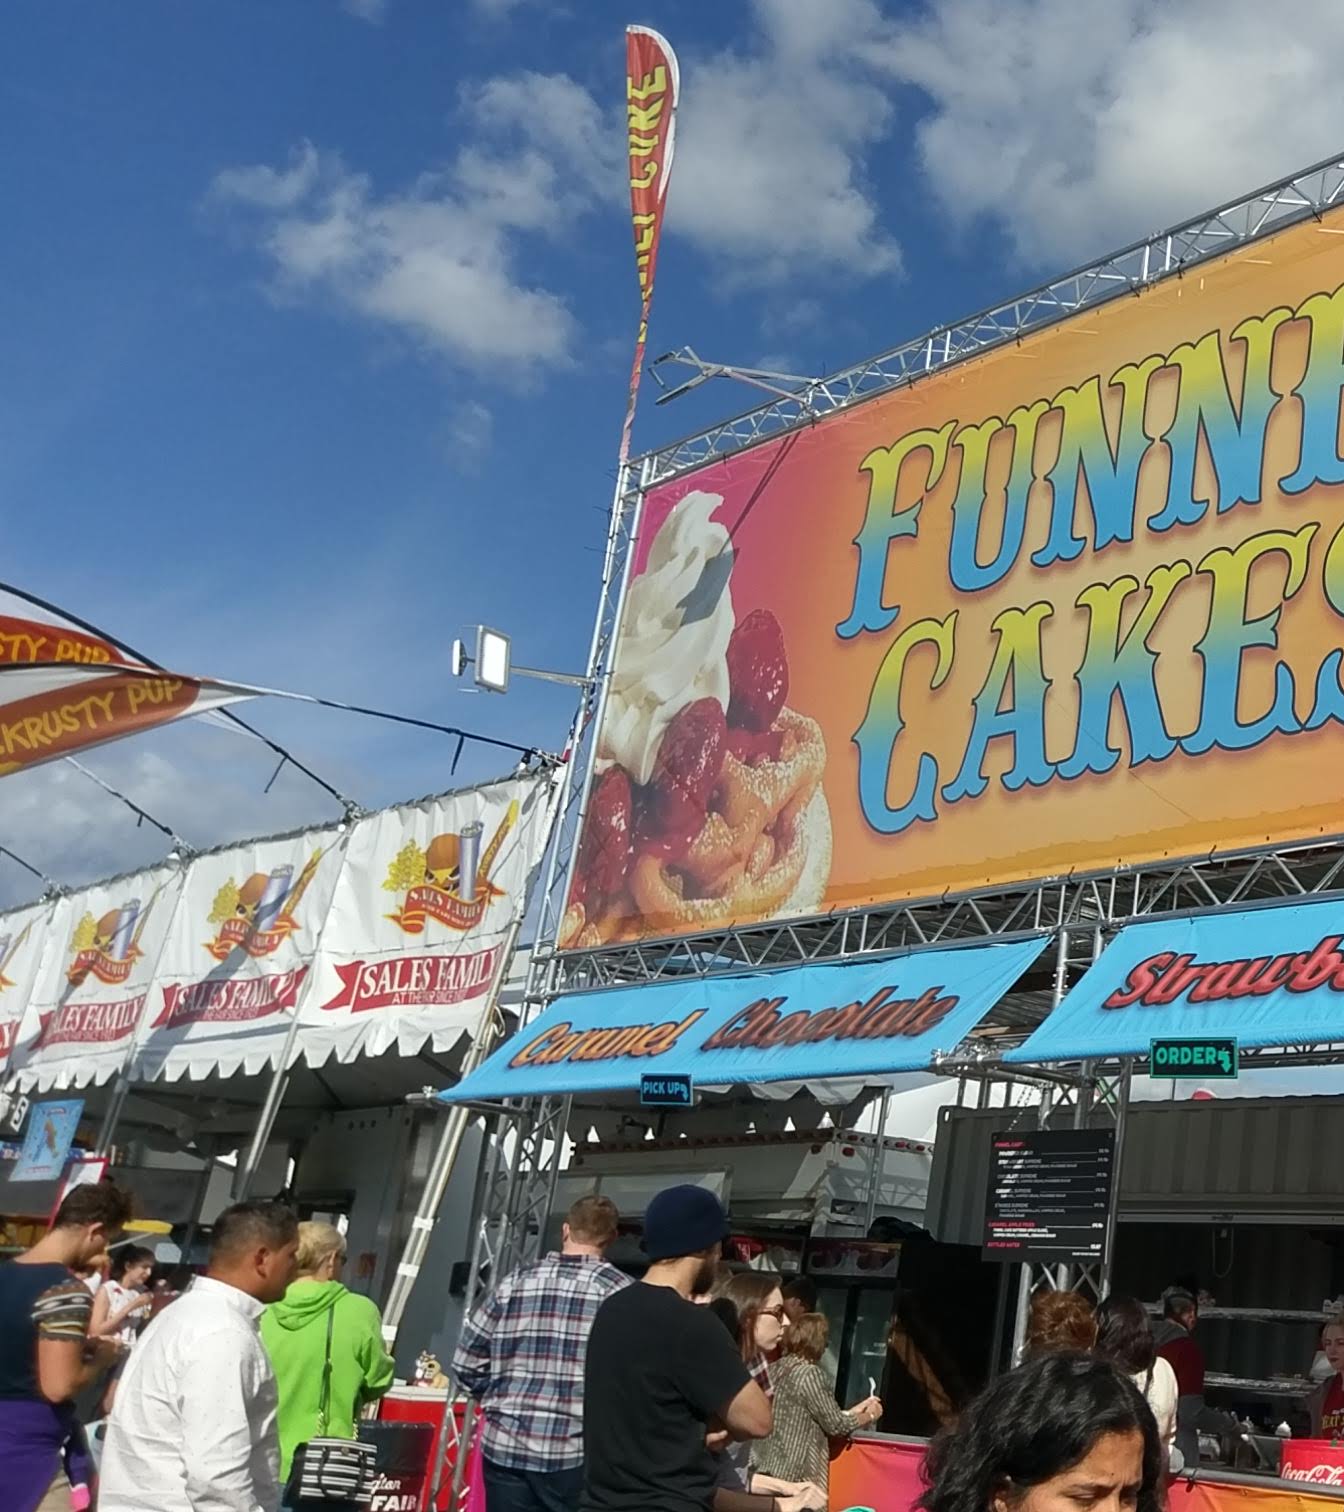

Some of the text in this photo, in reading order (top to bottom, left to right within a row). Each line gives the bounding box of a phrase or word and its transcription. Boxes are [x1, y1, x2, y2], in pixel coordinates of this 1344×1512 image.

[1, 679, 183, 754] KRUSTY PUP
[359, 950, 499, 999] SALES FAMILY
[82, 996, 144, 1031] FAMILY
[175, 980, 231, 1016] SALES
[508, 985, 961, 1068] Caramel Chocolate
[1155, 1046, 1217, 1066] ORDER
[643, 1081, 680, 1095] PICK UP
[370, 1494, 417, 1512] FAIR
